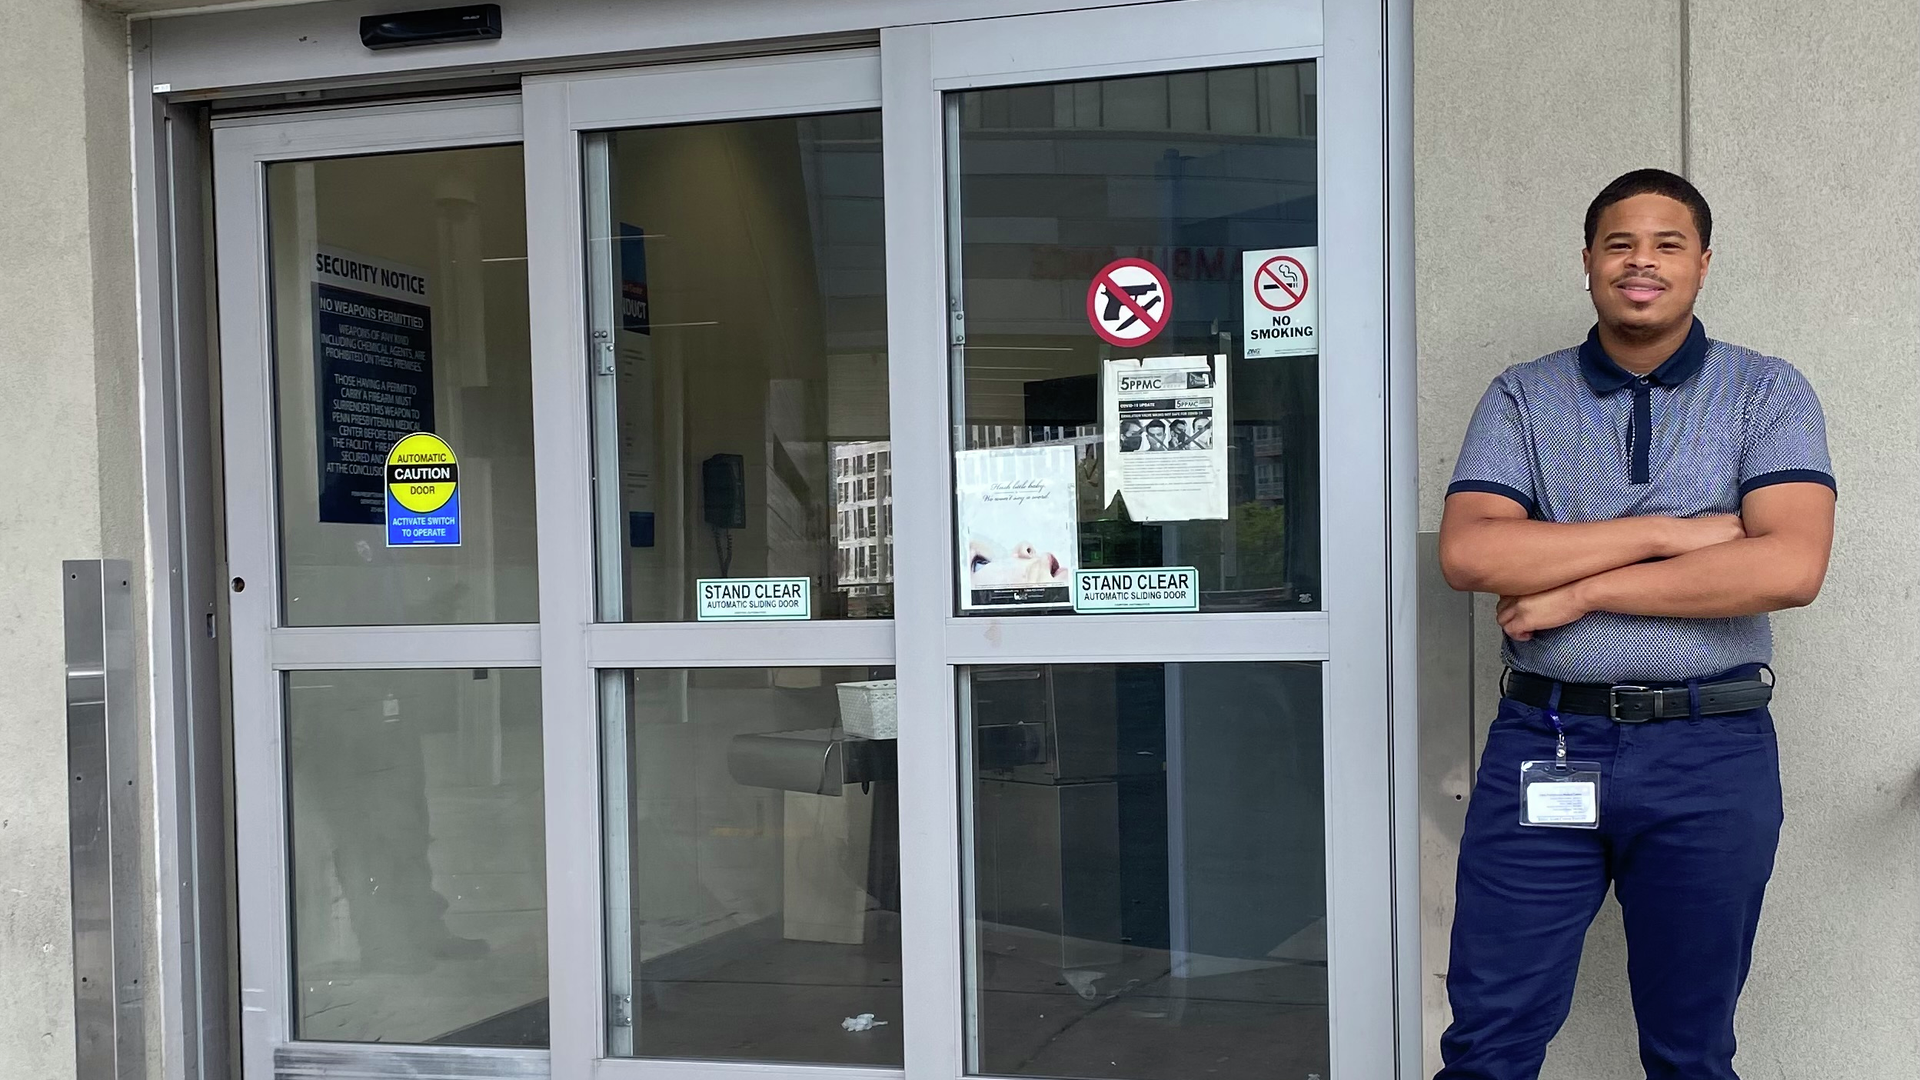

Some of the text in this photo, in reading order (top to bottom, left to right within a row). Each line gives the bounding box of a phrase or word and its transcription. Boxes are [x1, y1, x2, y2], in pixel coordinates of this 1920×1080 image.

[316, 253, 425, 295] SECURITY NOTICE
[320, 297, 424, 329] NO WEAPONS PERMITTED
[1272, 315, 1291, 326] NO
[339, 323, 409, 345] WEAPONS OF ANY KIND
[1250, 326, 1314, 340] SMOKING
[321, 333, 357, 349] INCLUDING
[357, 339, 389, 355] CHEMICAL
[415, 350, 426, 361] ARE
[325, 347, 363, 362] PROHIBITED
[364, 353, 374, 364] ON
[374, 354, 393, 368] THESE
[334, 373, 417, 395] THOSE HAVING A PERMIT TO
[1120, 376, 1162, 390] 5PPMC
[341, 387, 412, 406] CARRY A FIREARM MUST
[333, 399, 420, 420] SURRENDER THIS WEAPON TO
[332, 411, 422, 432] PENN PRESBYTERIAN MEDICAL
[339, 425, 363, 438] CENTER
[364, 428, 387, 440] BEFORE
[332, 437, 345, 448] THE
[341, 450, 370, 463] SECURED
[370, 454, 384, 465] AND
[397, 453, 447, 463] AUTOMATIC
[326, 462, 334, 473] AT
[334, 462, 348, 474] THE
[394, 467, 451, 480] CAUTION
[410, 486, 436, 495] DOOR
[392, 516, 456, 526] ACTIVATE SWITCH
[402, 528, 446, 538] TO OPERATE
[1081, 574, 1133, 591] STAND
[1137, 573, 1189, 590] CLEAR
[704, 583, 801, 599] STAND CLEAR
[1084, 590, 1187, 601] AUTOMATIC SLIDING DOOR
[707, 599, 799, 609] AUTOMATIC SLIDING DOOR
